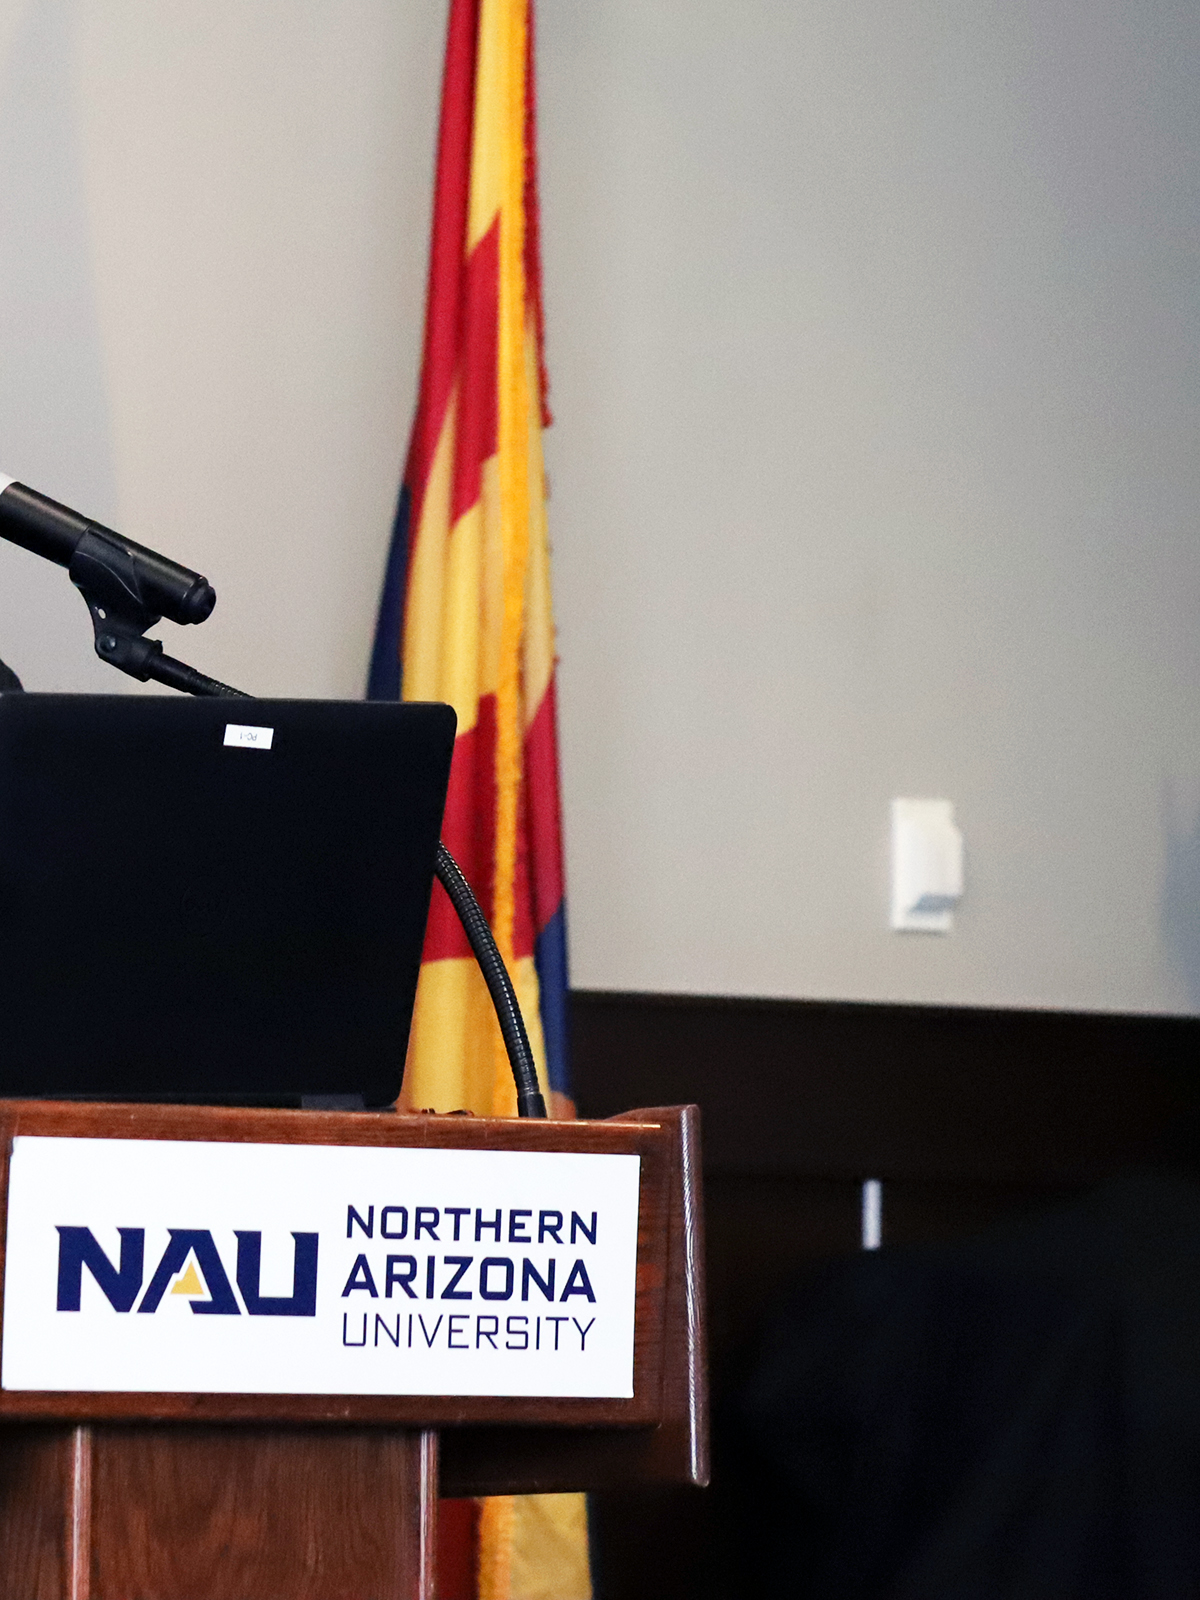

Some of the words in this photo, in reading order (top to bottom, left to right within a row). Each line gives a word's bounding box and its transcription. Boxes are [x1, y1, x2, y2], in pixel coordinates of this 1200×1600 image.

[347, 1205, 598, 1244] NORTHERN
[56, 1226, 319, 1316] NAU
[342, 1254, 597, 1302] ARIZONA
[343, 1313, 596, 1350] UNIVERSITY
